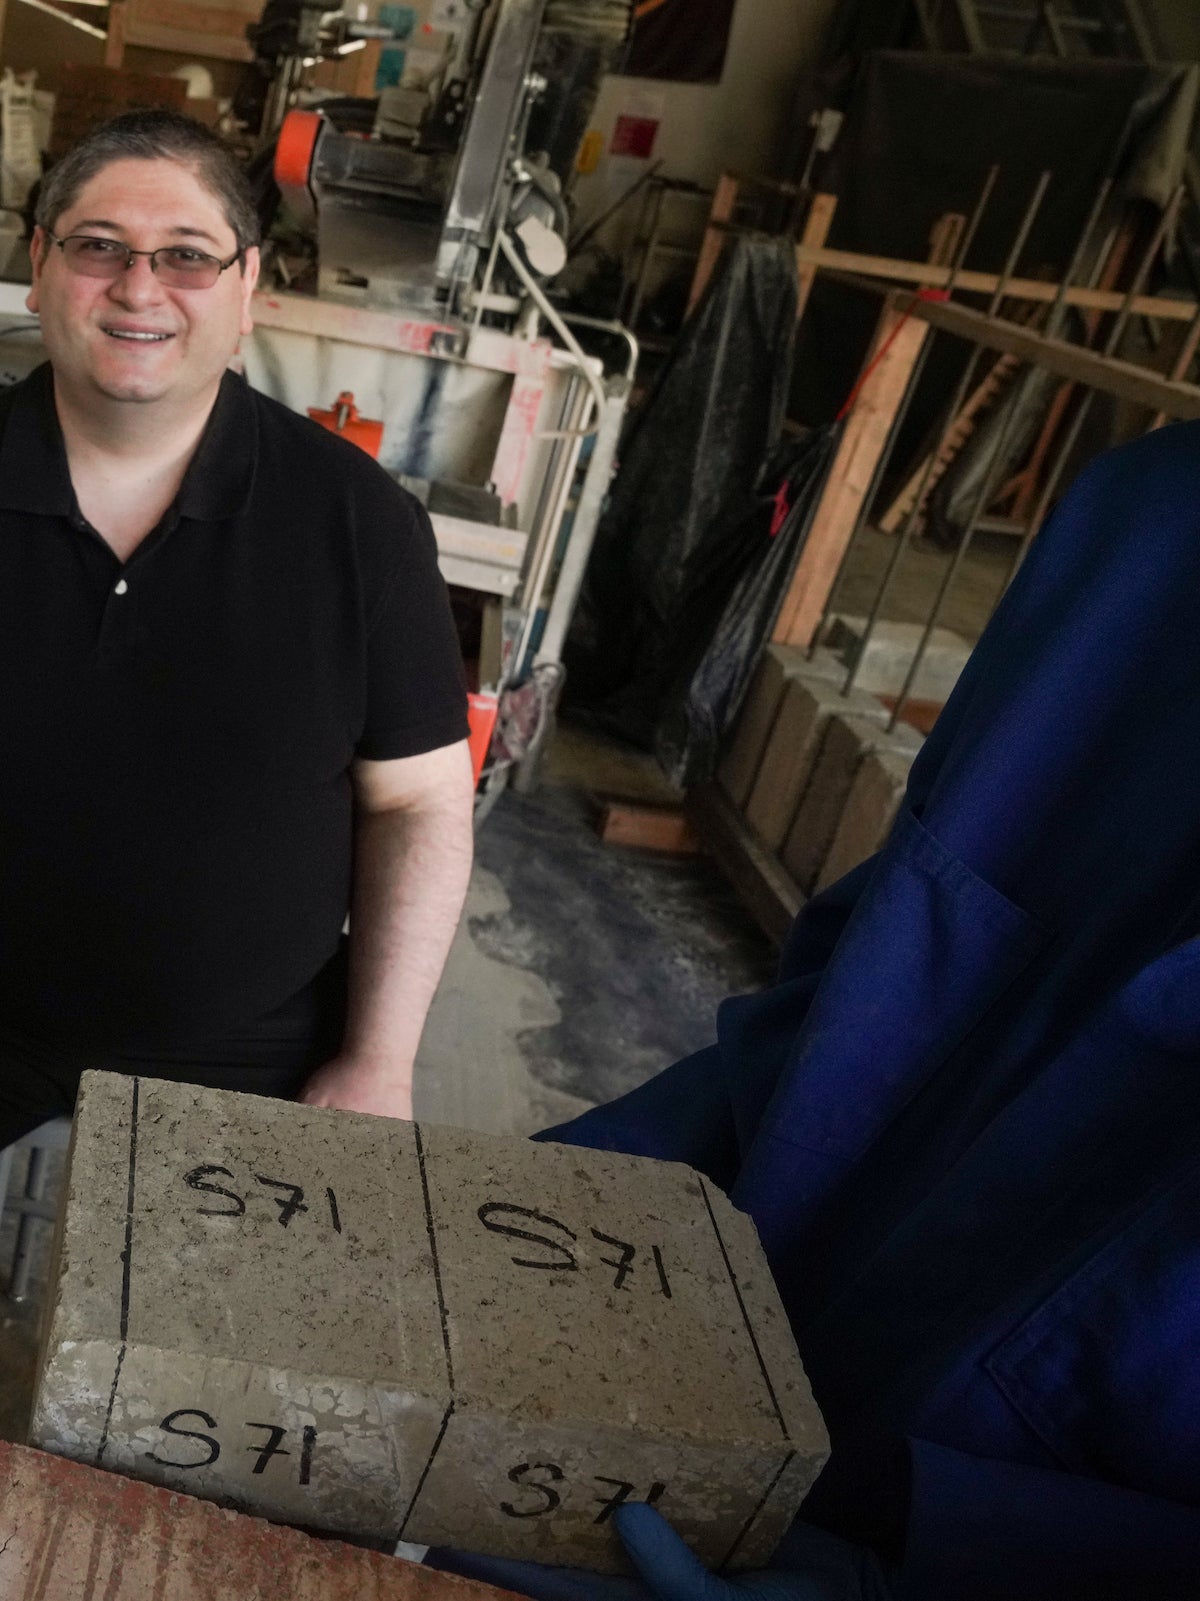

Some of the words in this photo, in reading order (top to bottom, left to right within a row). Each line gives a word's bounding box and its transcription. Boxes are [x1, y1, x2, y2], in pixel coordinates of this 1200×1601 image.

[182, 1164, 342, 1235] S71
[477, 1201, 674, 1300] S71
[144, 1408, 317, 1486] S71
